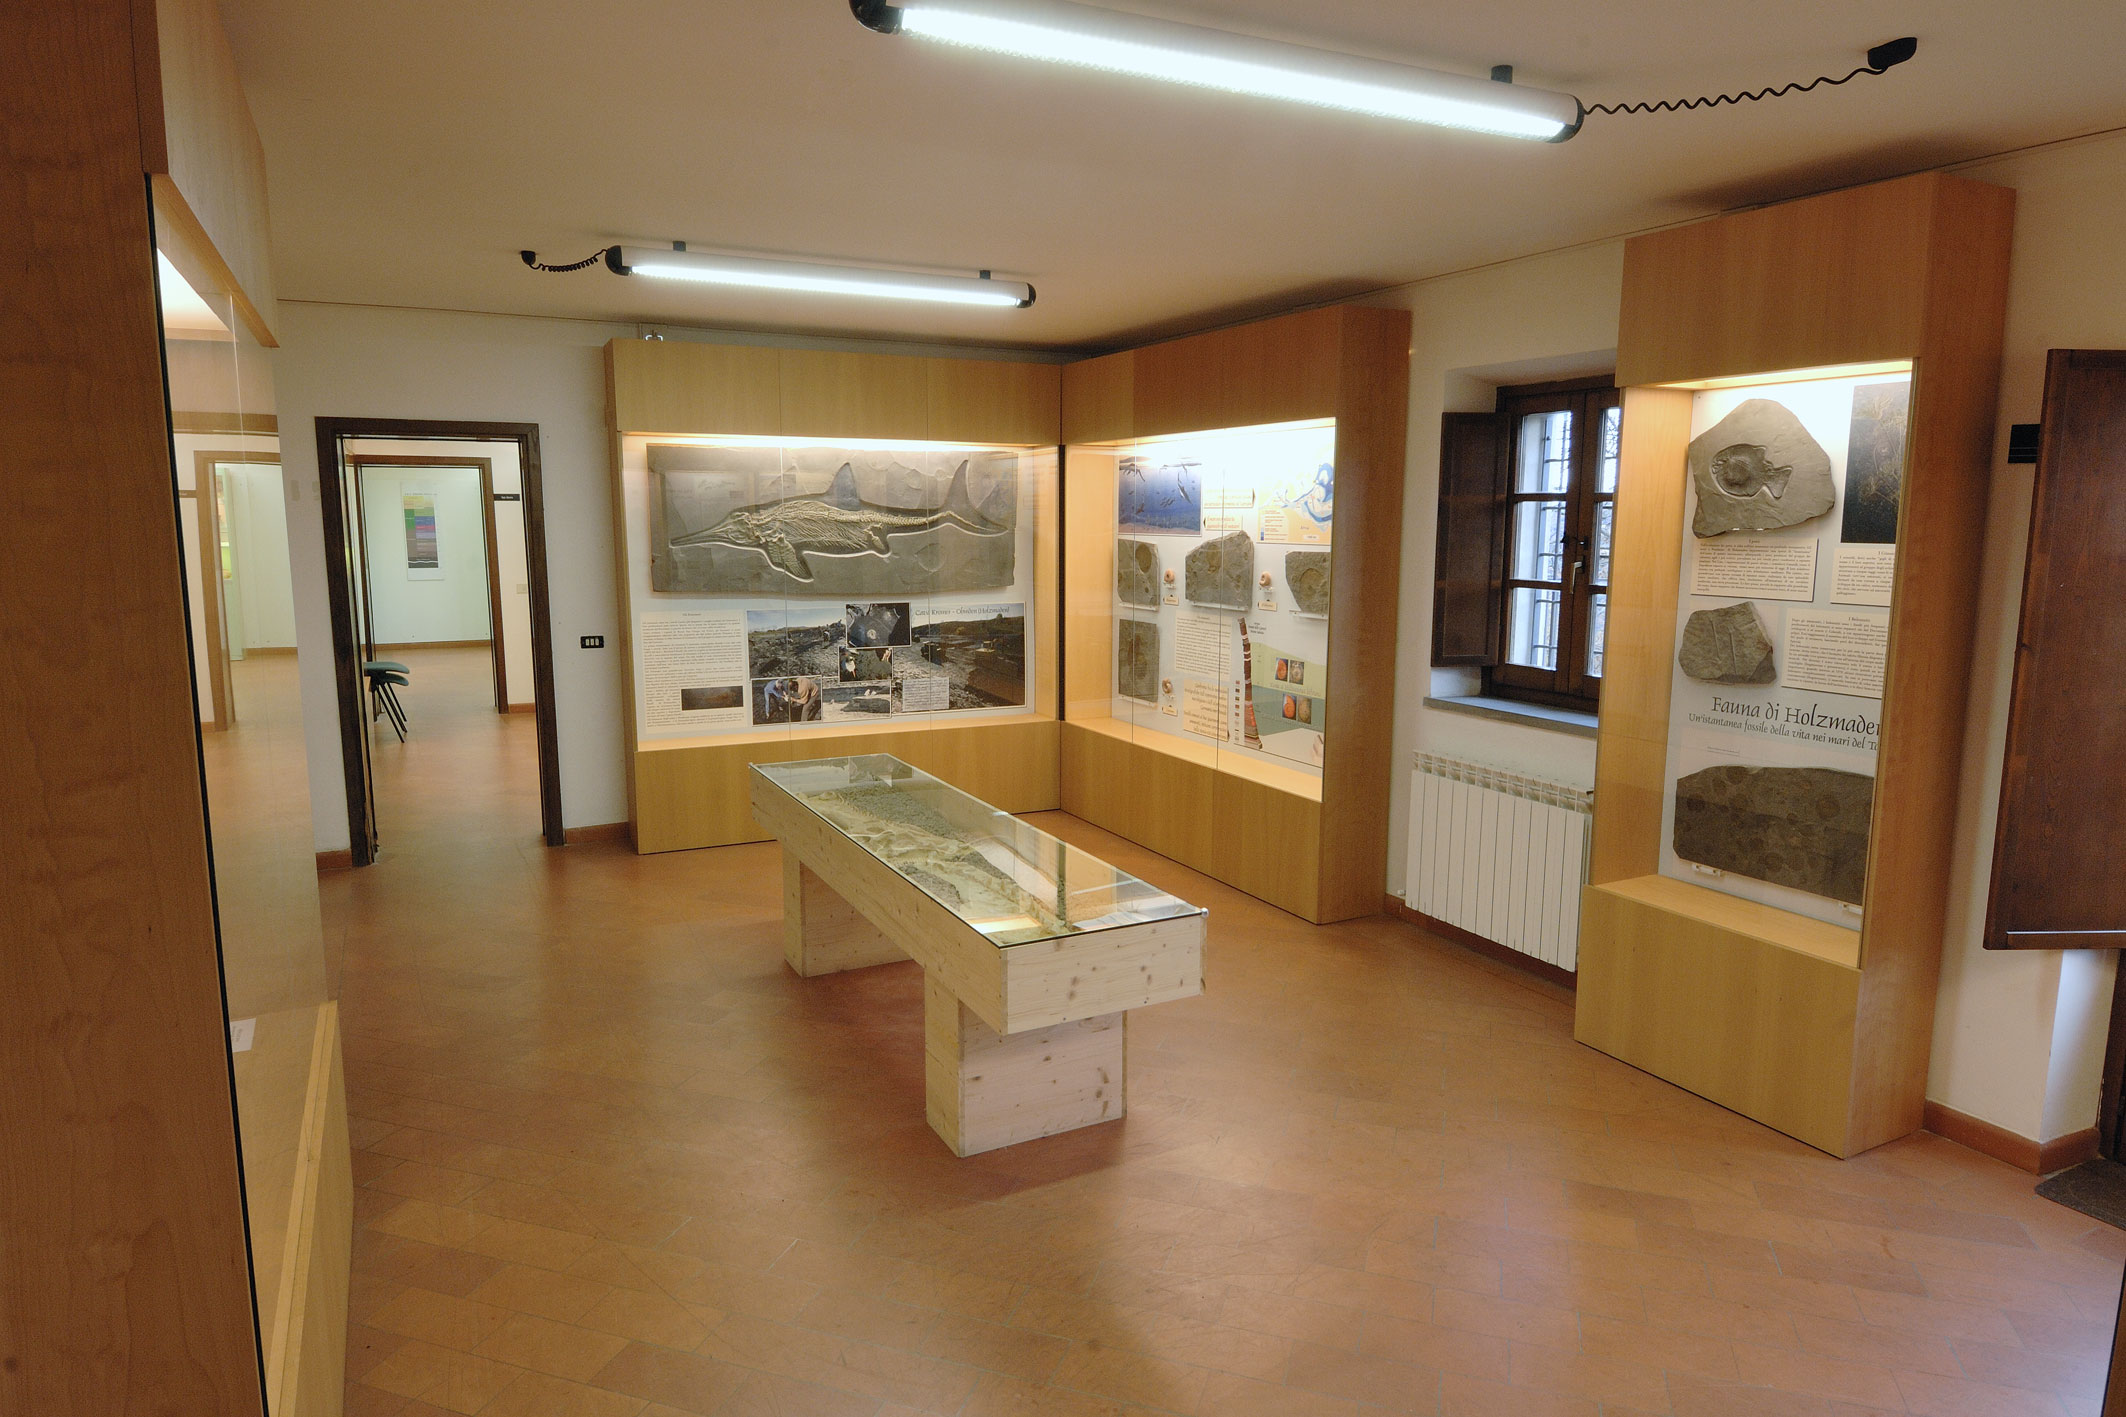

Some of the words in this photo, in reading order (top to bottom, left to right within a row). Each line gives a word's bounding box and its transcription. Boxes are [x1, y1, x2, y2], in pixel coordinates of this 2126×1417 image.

[1711, 696, 1761, 718] Fauna
[1765, 701, 1780, 721] di
[1688, 712, 1742, 729] Un'istantanea
[1743, 718, 1769, 733] fossile
[1770, 723, 1790, 737] della
[1792, 728, 1811, 740] vita
[1812, 732, 1826, 743] nei
[1828, 736, 1850, 747] mari
[1851, 736, 1866, 749] del
